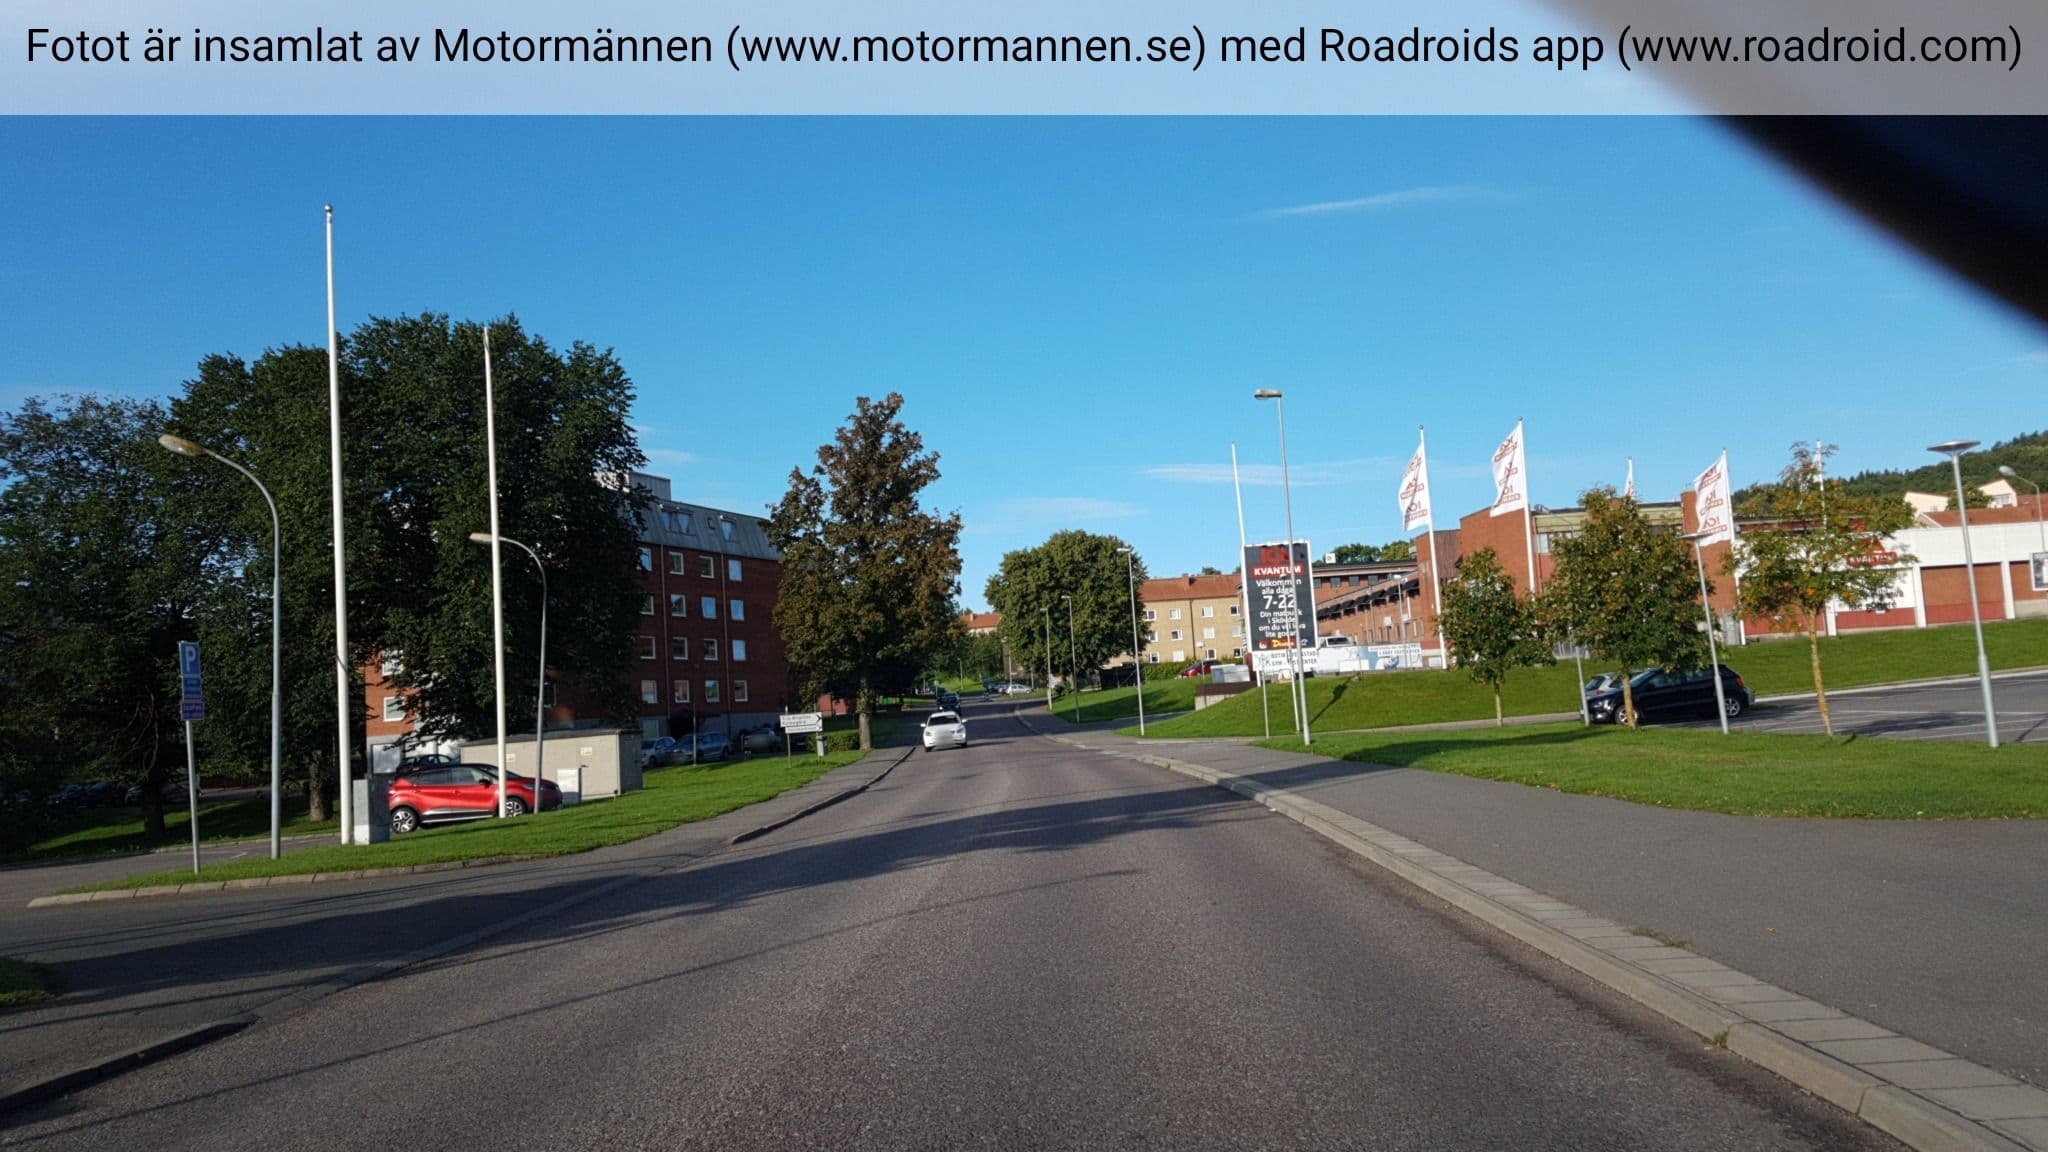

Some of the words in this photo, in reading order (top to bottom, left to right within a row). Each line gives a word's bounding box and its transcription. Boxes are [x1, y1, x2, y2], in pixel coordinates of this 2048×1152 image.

[1254, 565, 1301, 576] KVANTUM
[1256, 578, 1301, 587] Välkommn
[1276, 585, 1295, 594] daga
[1263, 594, 1295, 609] 7-22
[184, 645, 196, 672] P
